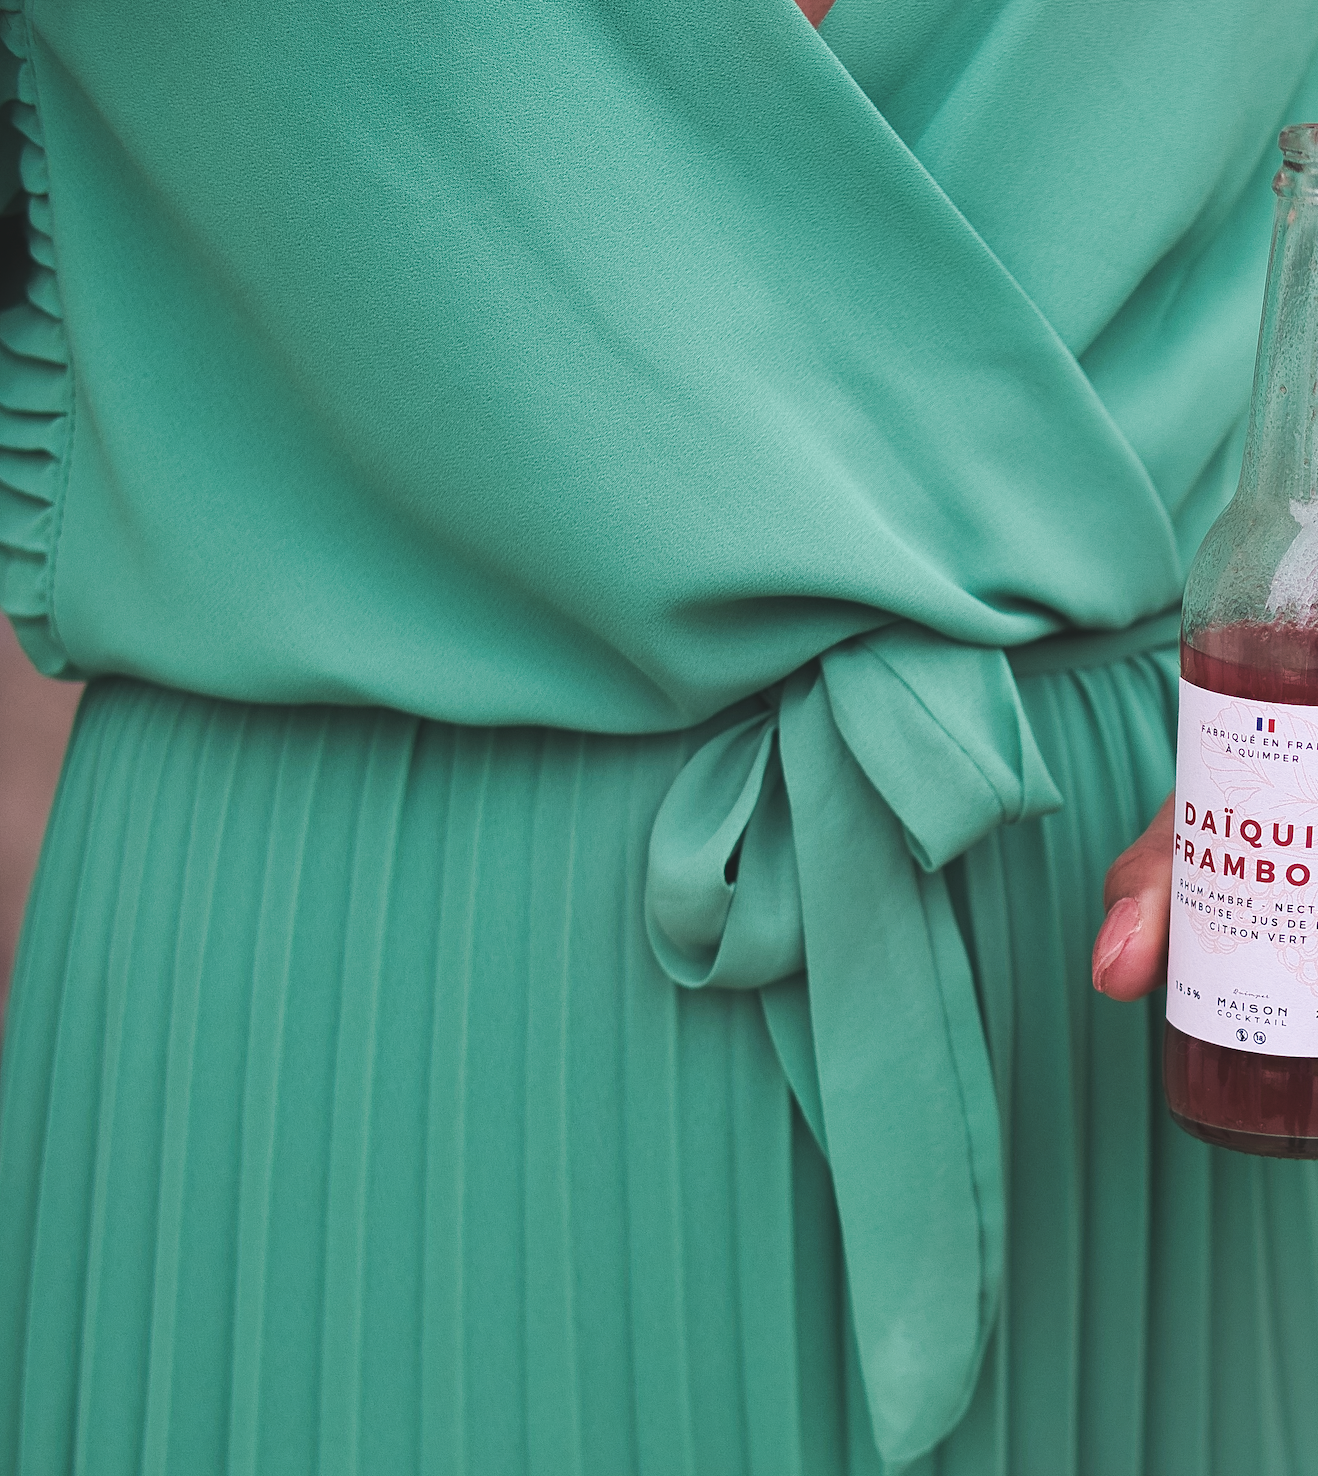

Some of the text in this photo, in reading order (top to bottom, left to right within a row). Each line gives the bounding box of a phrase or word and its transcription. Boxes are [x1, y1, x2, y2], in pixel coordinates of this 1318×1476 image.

[1201, 724, 1256, 744] FABRIQUÉ
[1263, 738, 1279, 747] EN
[1226, 744, 1300, 762] À QUIMPER
[1180, 878, 1204, 895] RHUM
[1209, 891, 1252, 908] AMBRÉ
[1176, 892, 1232, 919] FRAMBOISE
[1252, 916, 1278, 926] JUS
[1288, 920, 1306, 929] DE
[1210, 922, 1307, 944] CITRON VERT
[1218, 998, 1288, 1016] MAISON
[1218, 1010, 1286, 1026] COCKTAIL
